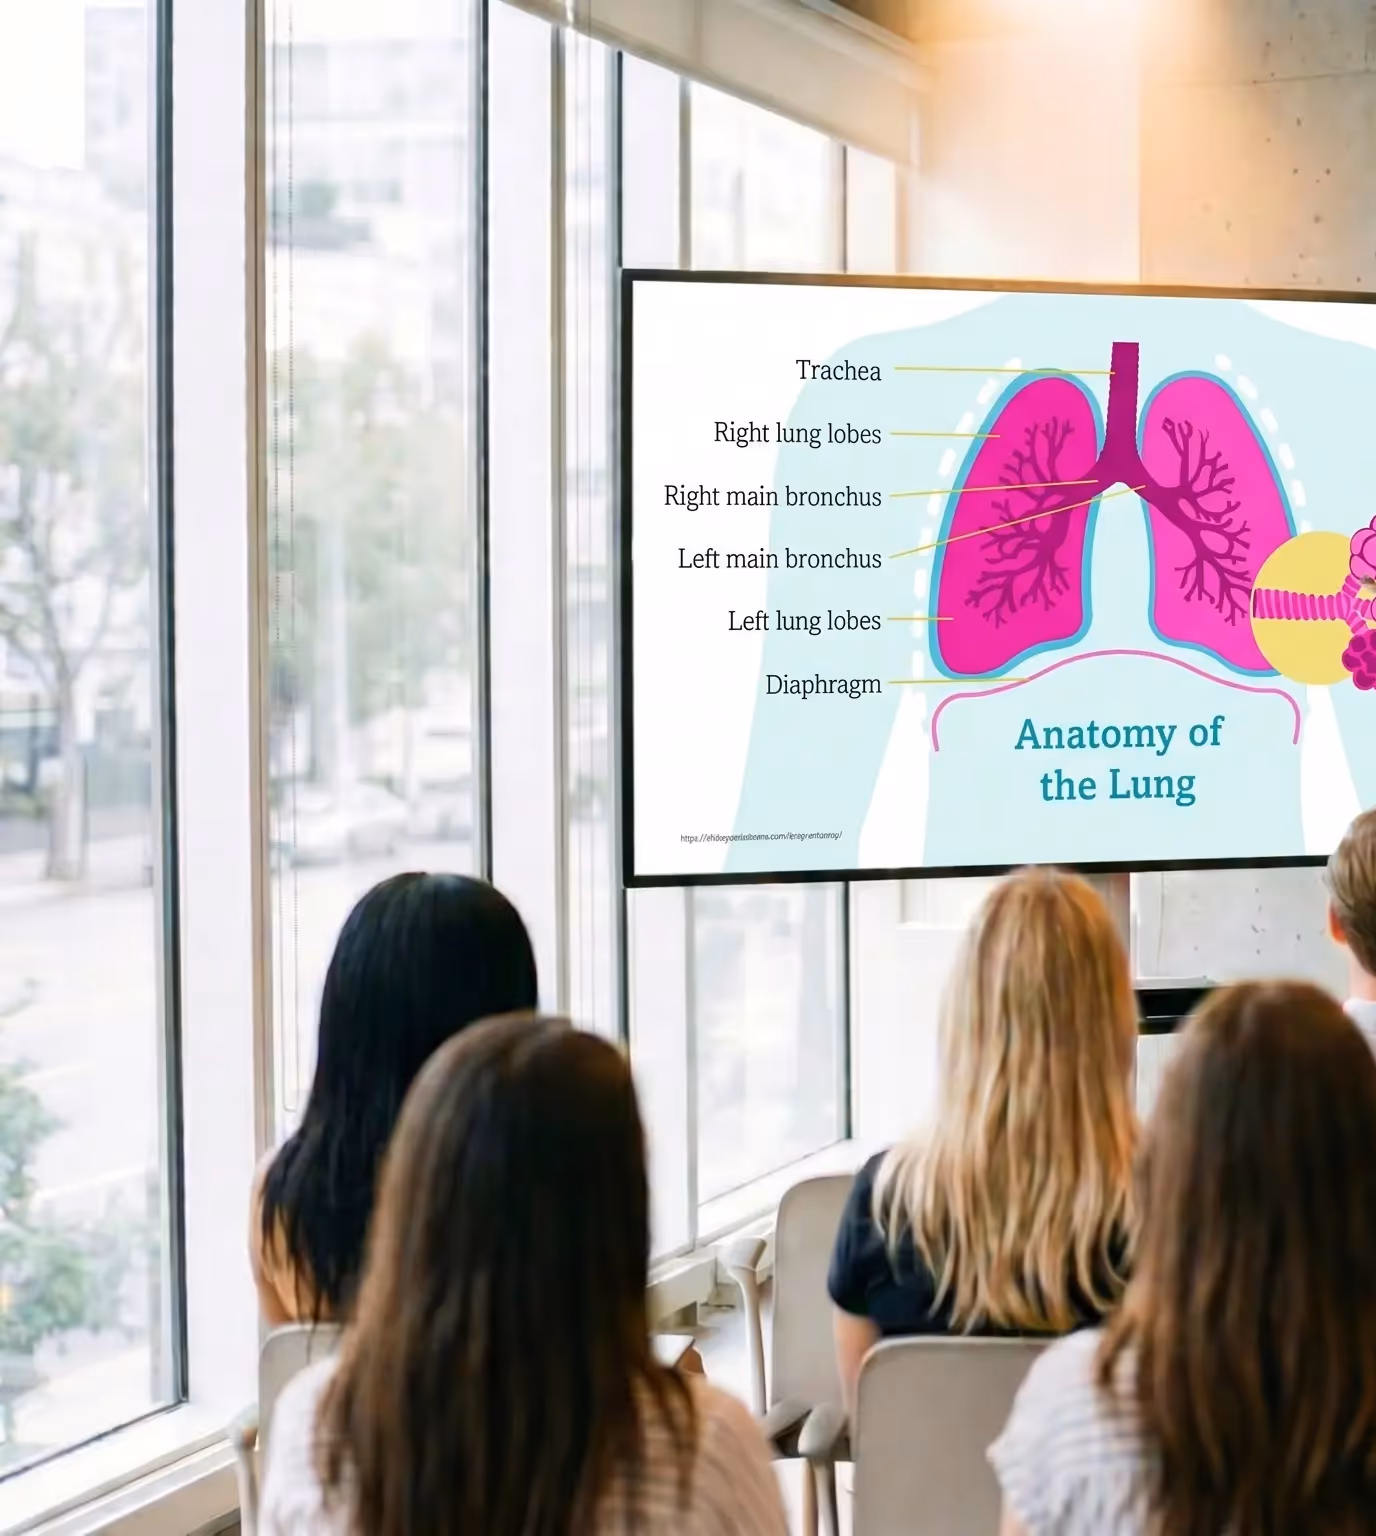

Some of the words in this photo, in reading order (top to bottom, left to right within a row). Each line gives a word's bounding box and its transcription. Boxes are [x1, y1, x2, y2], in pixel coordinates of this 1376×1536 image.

[796, 360, 882, 382] Trachea
[714, 421, 769, 449] Right
[776, 422, 822, 449] lung
[828, 423, 881, 444] lobes
[664, 485, 720, 511] Right
[727, 485, 778, 506] main
[785, 485, 882, 507] bronchus
[678, 547, 720, 569] Left
[726, 547, 778, 569] main
[785, 547, 882, 569] bronchus
[728, 610, 769, 631] Left
[776, 610, 822, 636] lung
[828, 610, 881, 631] lobes
[766, 674, 882, 700] Diaphragm
[1014, 718, 1178, 757] Anatomy
[1189, 714, 1226, 747] of
[1040, 768, 1097, 801] the
[1109, 768, 1196, 807] Lung
